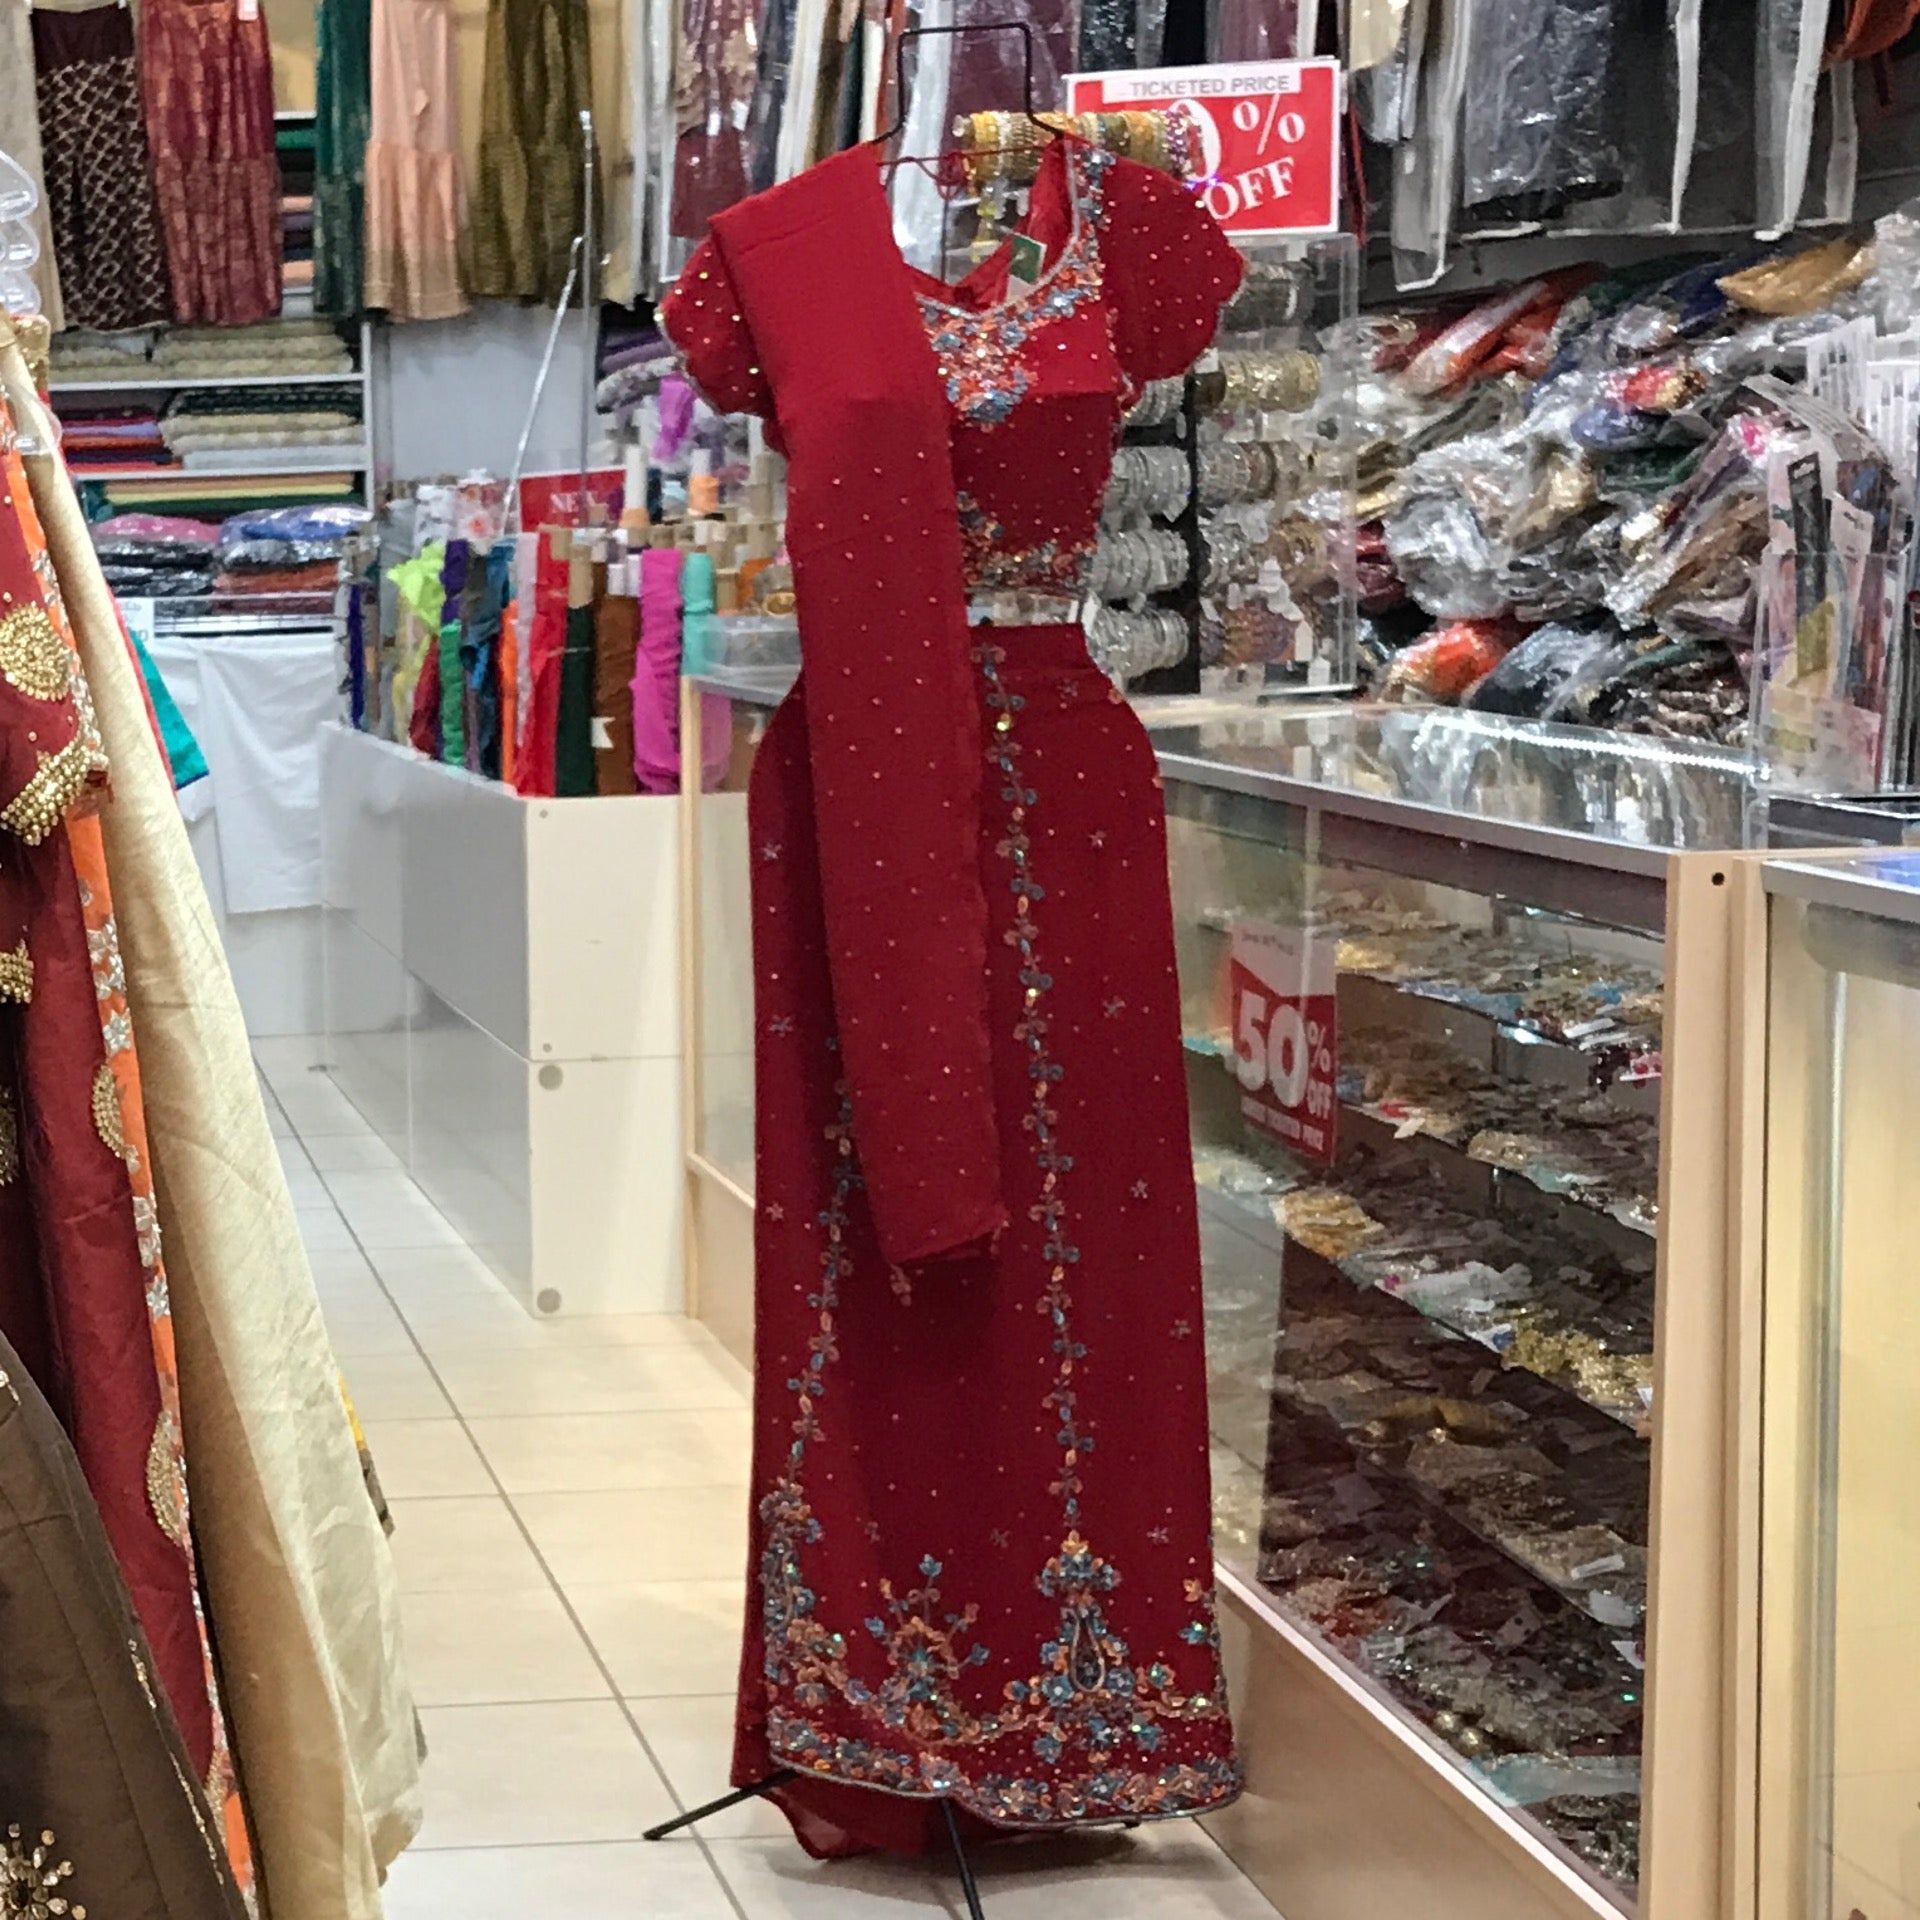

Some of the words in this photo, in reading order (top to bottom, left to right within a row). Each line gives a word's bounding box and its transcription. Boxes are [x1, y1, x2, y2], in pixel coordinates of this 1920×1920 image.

[1130, 78, 1226, 97] TICKETED
[1230, 75, 1290, 93] PRICE
[1202, 156, 1295, 220] OFF
[1236, 988, 1331, 1107] 50%
